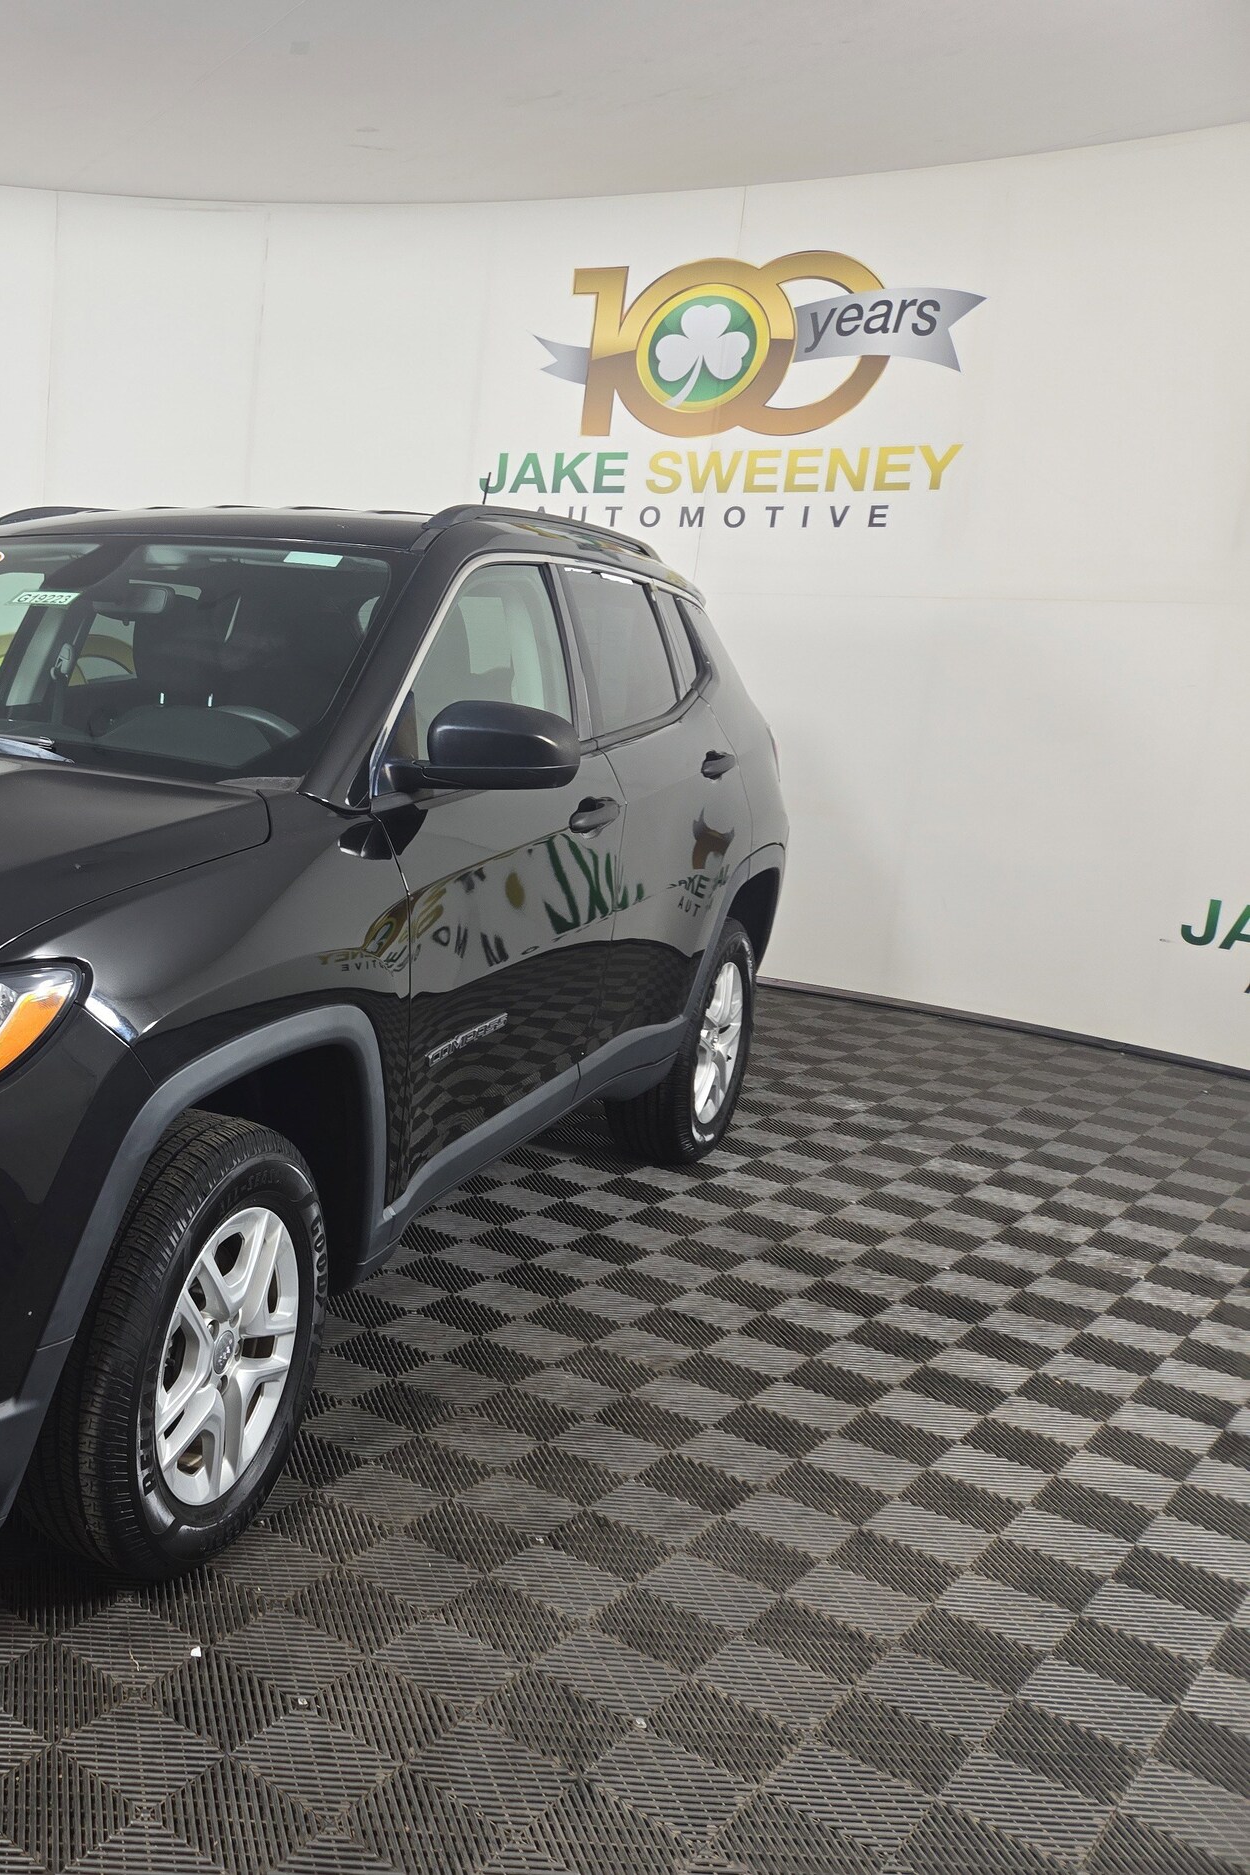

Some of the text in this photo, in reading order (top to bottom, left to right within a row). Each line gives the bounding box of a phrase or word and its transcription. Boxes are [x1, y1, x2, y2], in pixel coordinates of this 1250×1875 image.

[573, 250, 891, 438] 100
[804, 299, 941, 353] years
[479, 444, 964, 495] JAKE SWEENEY
